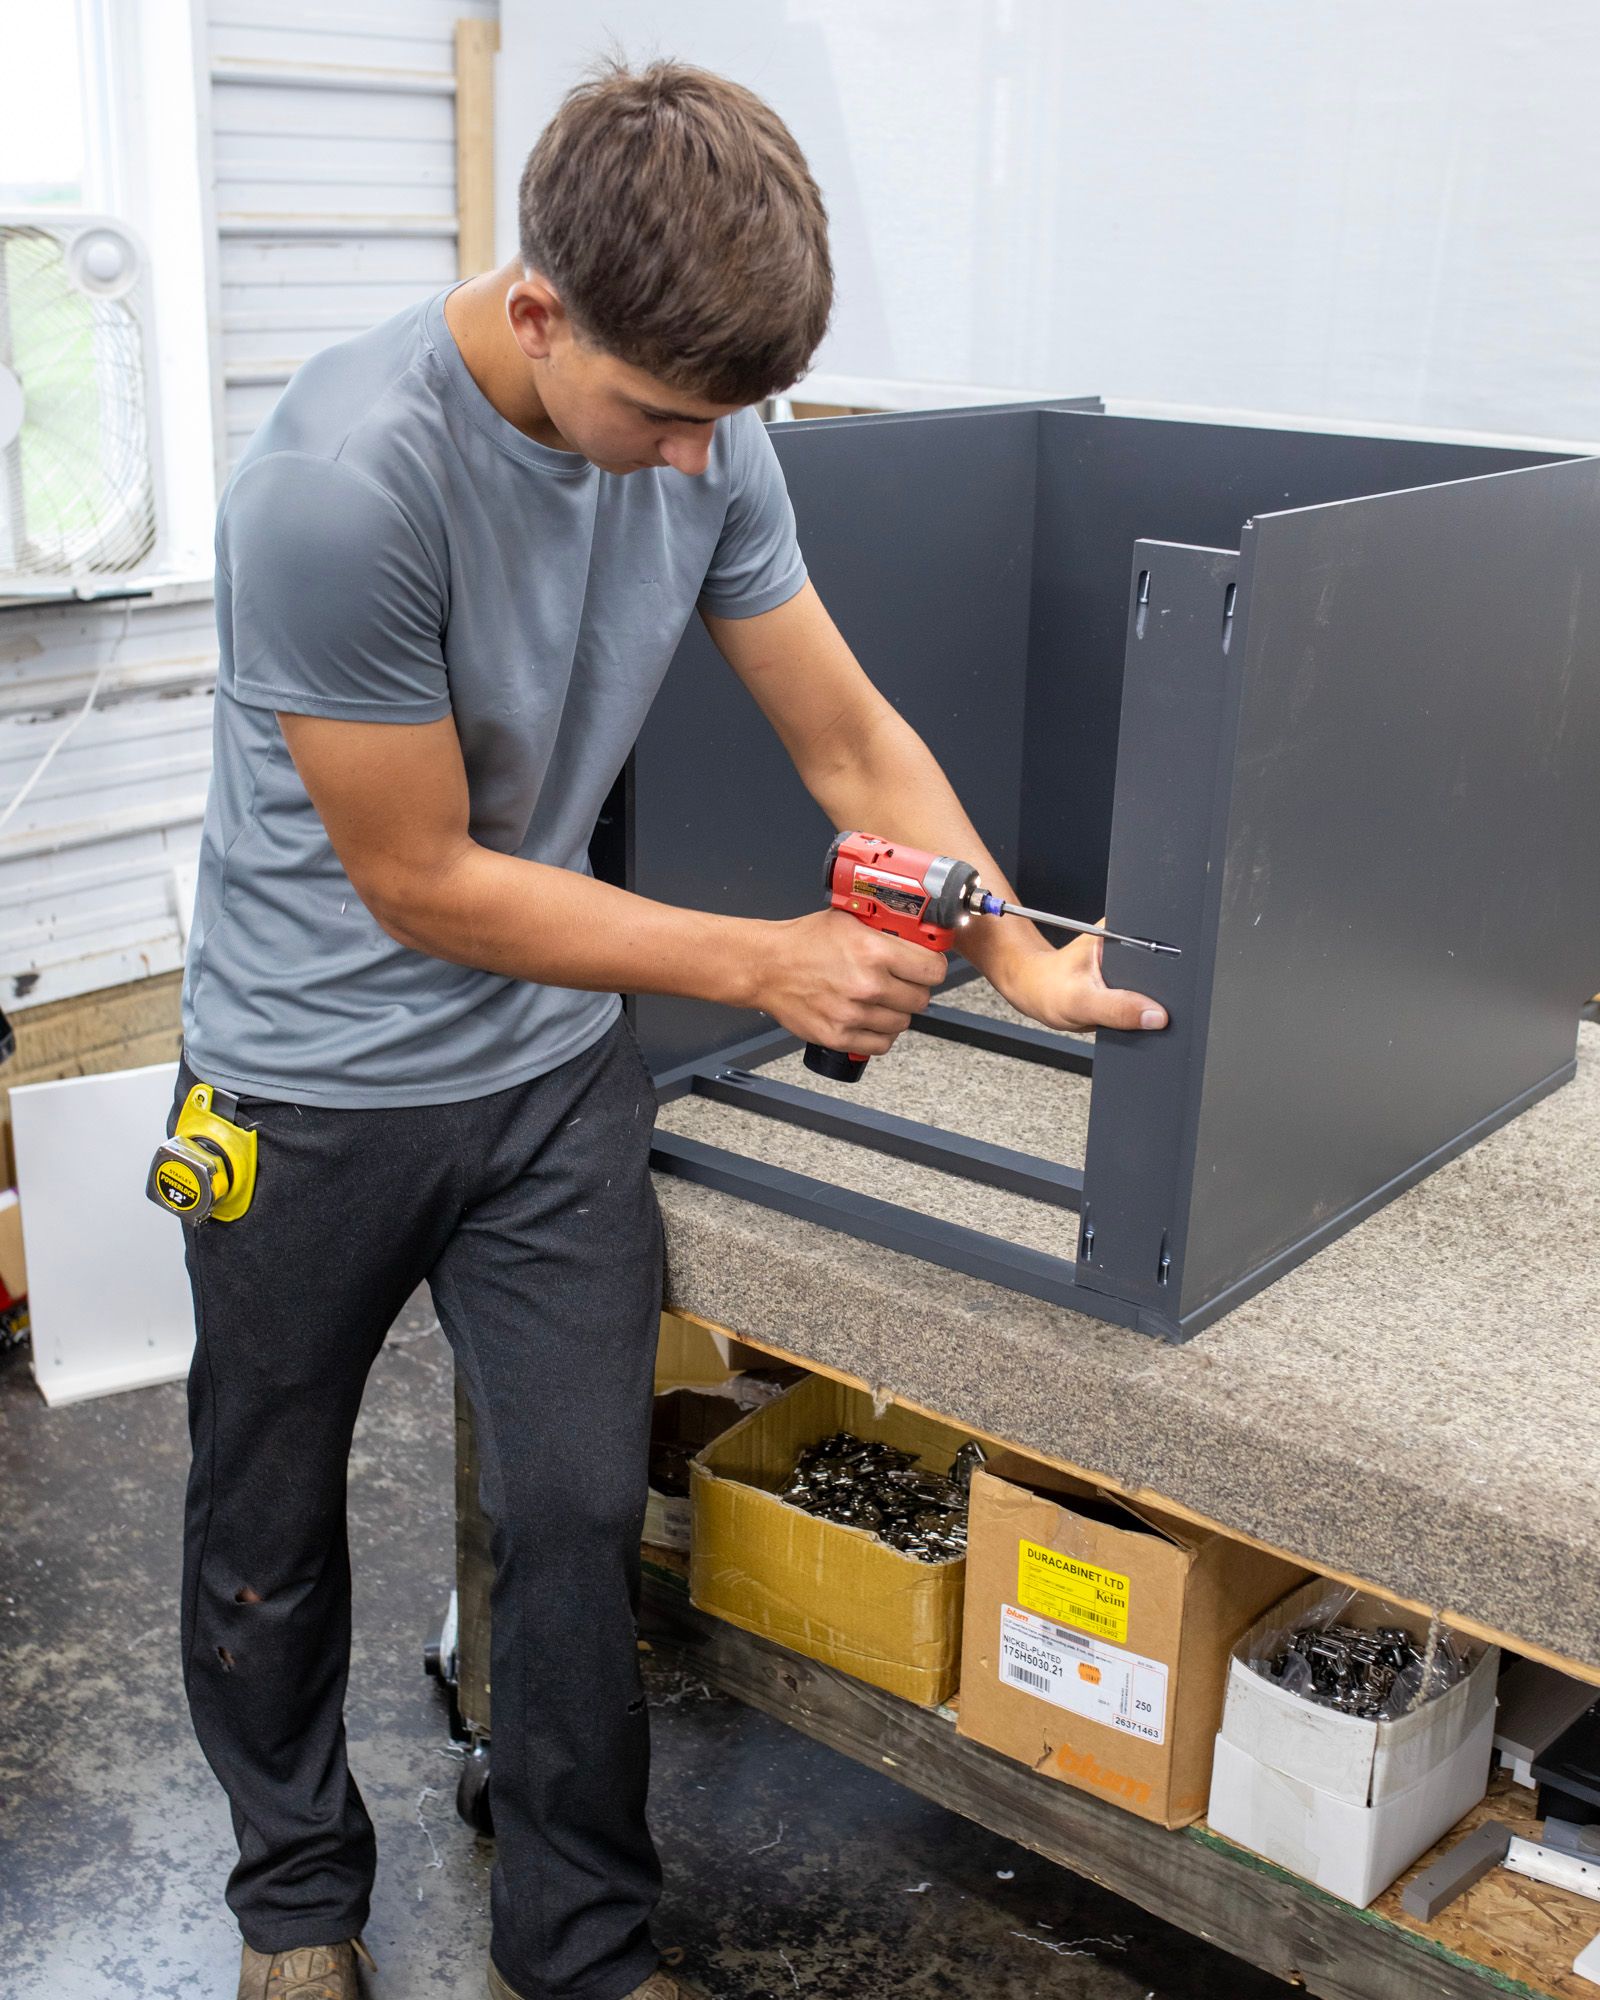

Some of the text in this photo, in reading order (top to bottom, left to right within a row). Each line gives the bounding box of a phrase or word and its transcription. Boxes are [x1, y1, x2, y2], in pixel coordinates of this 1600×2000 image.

[169, 1169, 192, 1185] STANLEY
[1027, 1548, 1102, 1583] DURACABINET
[1104, 1576, 1124, 1591] LTD
[1096, 1589, 1125, 1608] Keim
[1006, 1607, 1029, 1622] blum
[1003, 1634, 1062, 1665] NICKEL-PLATED
[1003, 1644, 1063, 1678] 175H5030.21
[1135, 1699, 1152, 1713] 250
[1115, 1716, 1159, 1739] 26371463
[1056, 1743, 1152, 1805] blum
